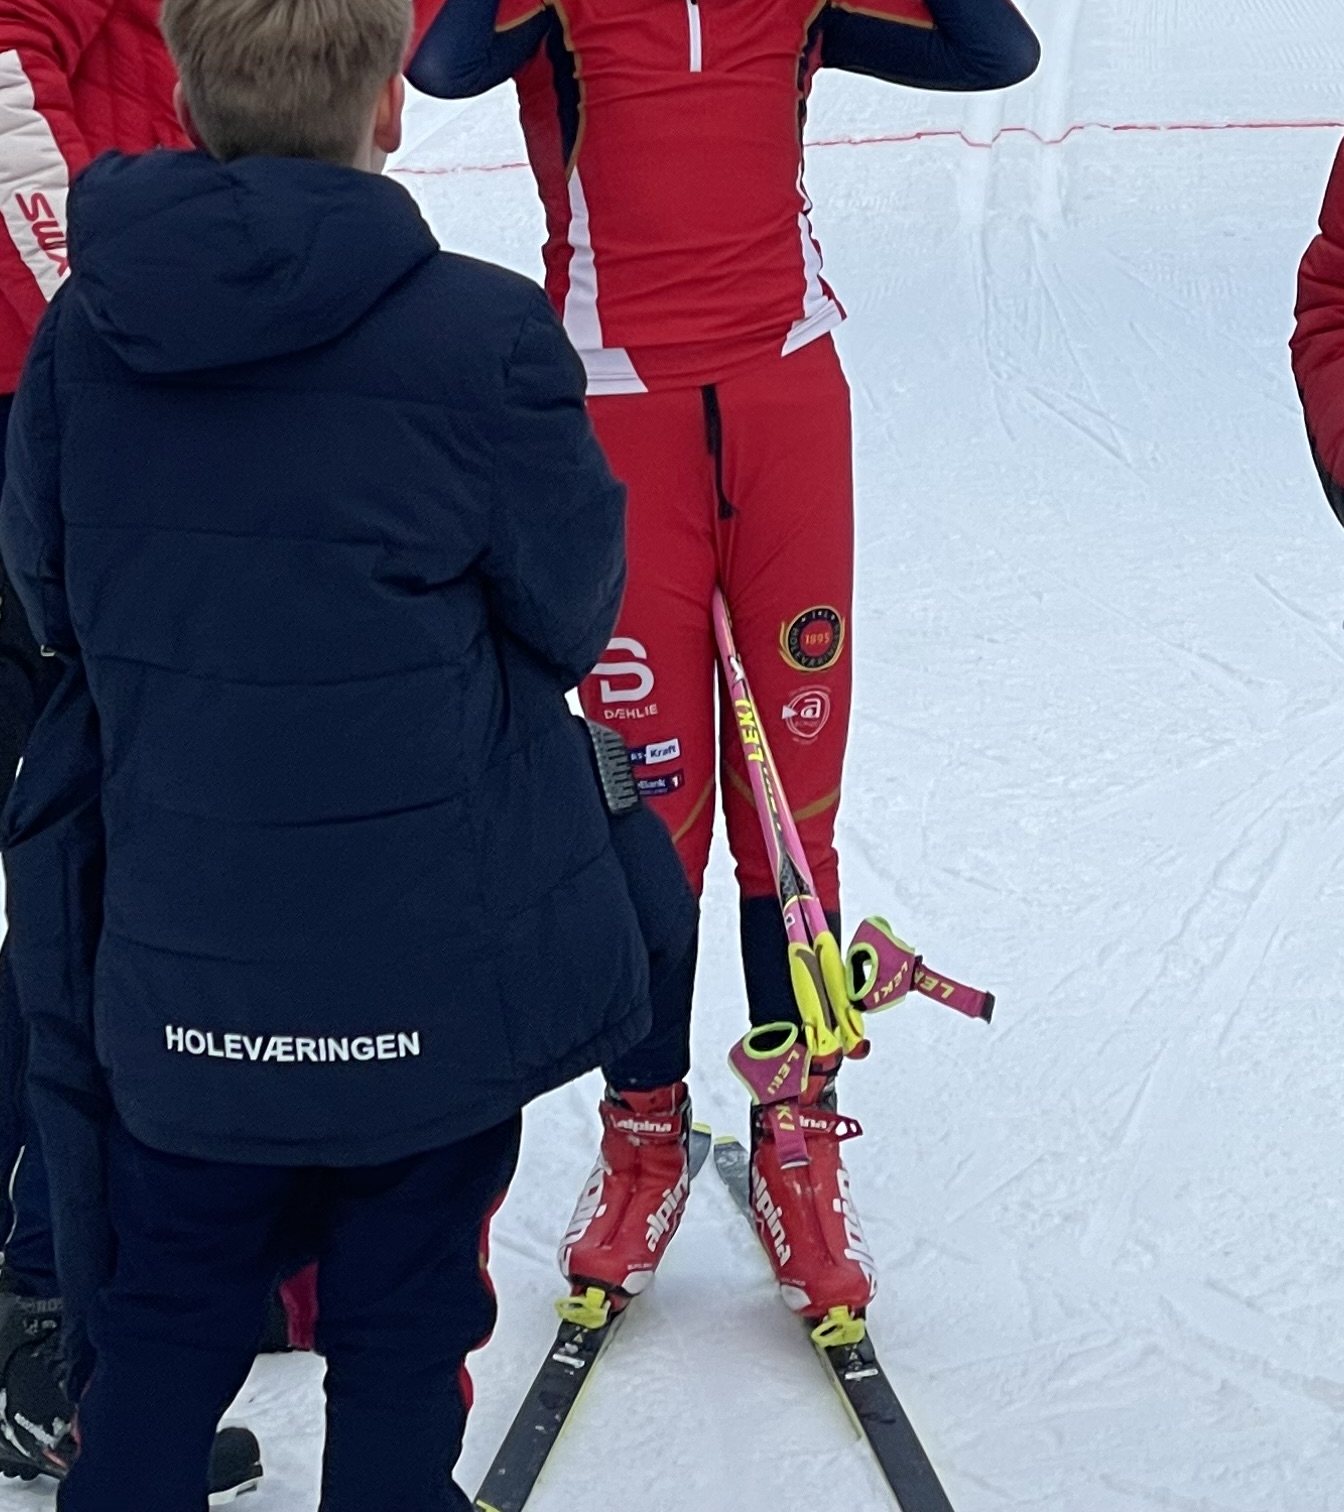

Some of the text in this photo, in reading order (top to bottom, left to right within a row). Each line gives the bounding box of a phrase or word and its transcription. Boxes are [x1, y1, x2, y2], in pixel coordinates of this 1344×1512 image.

[604, 704, 659, 720] DÆHLIE
[734, 698, 765, 763] LEKI
[871, 960, 909, 1004] LEKI
[165, 1024, 421, 1062] HOLEVÆRINGEN
[766, 1049, 800, 1095] LEKI
[616, 1118, 672, 1133] alpina
